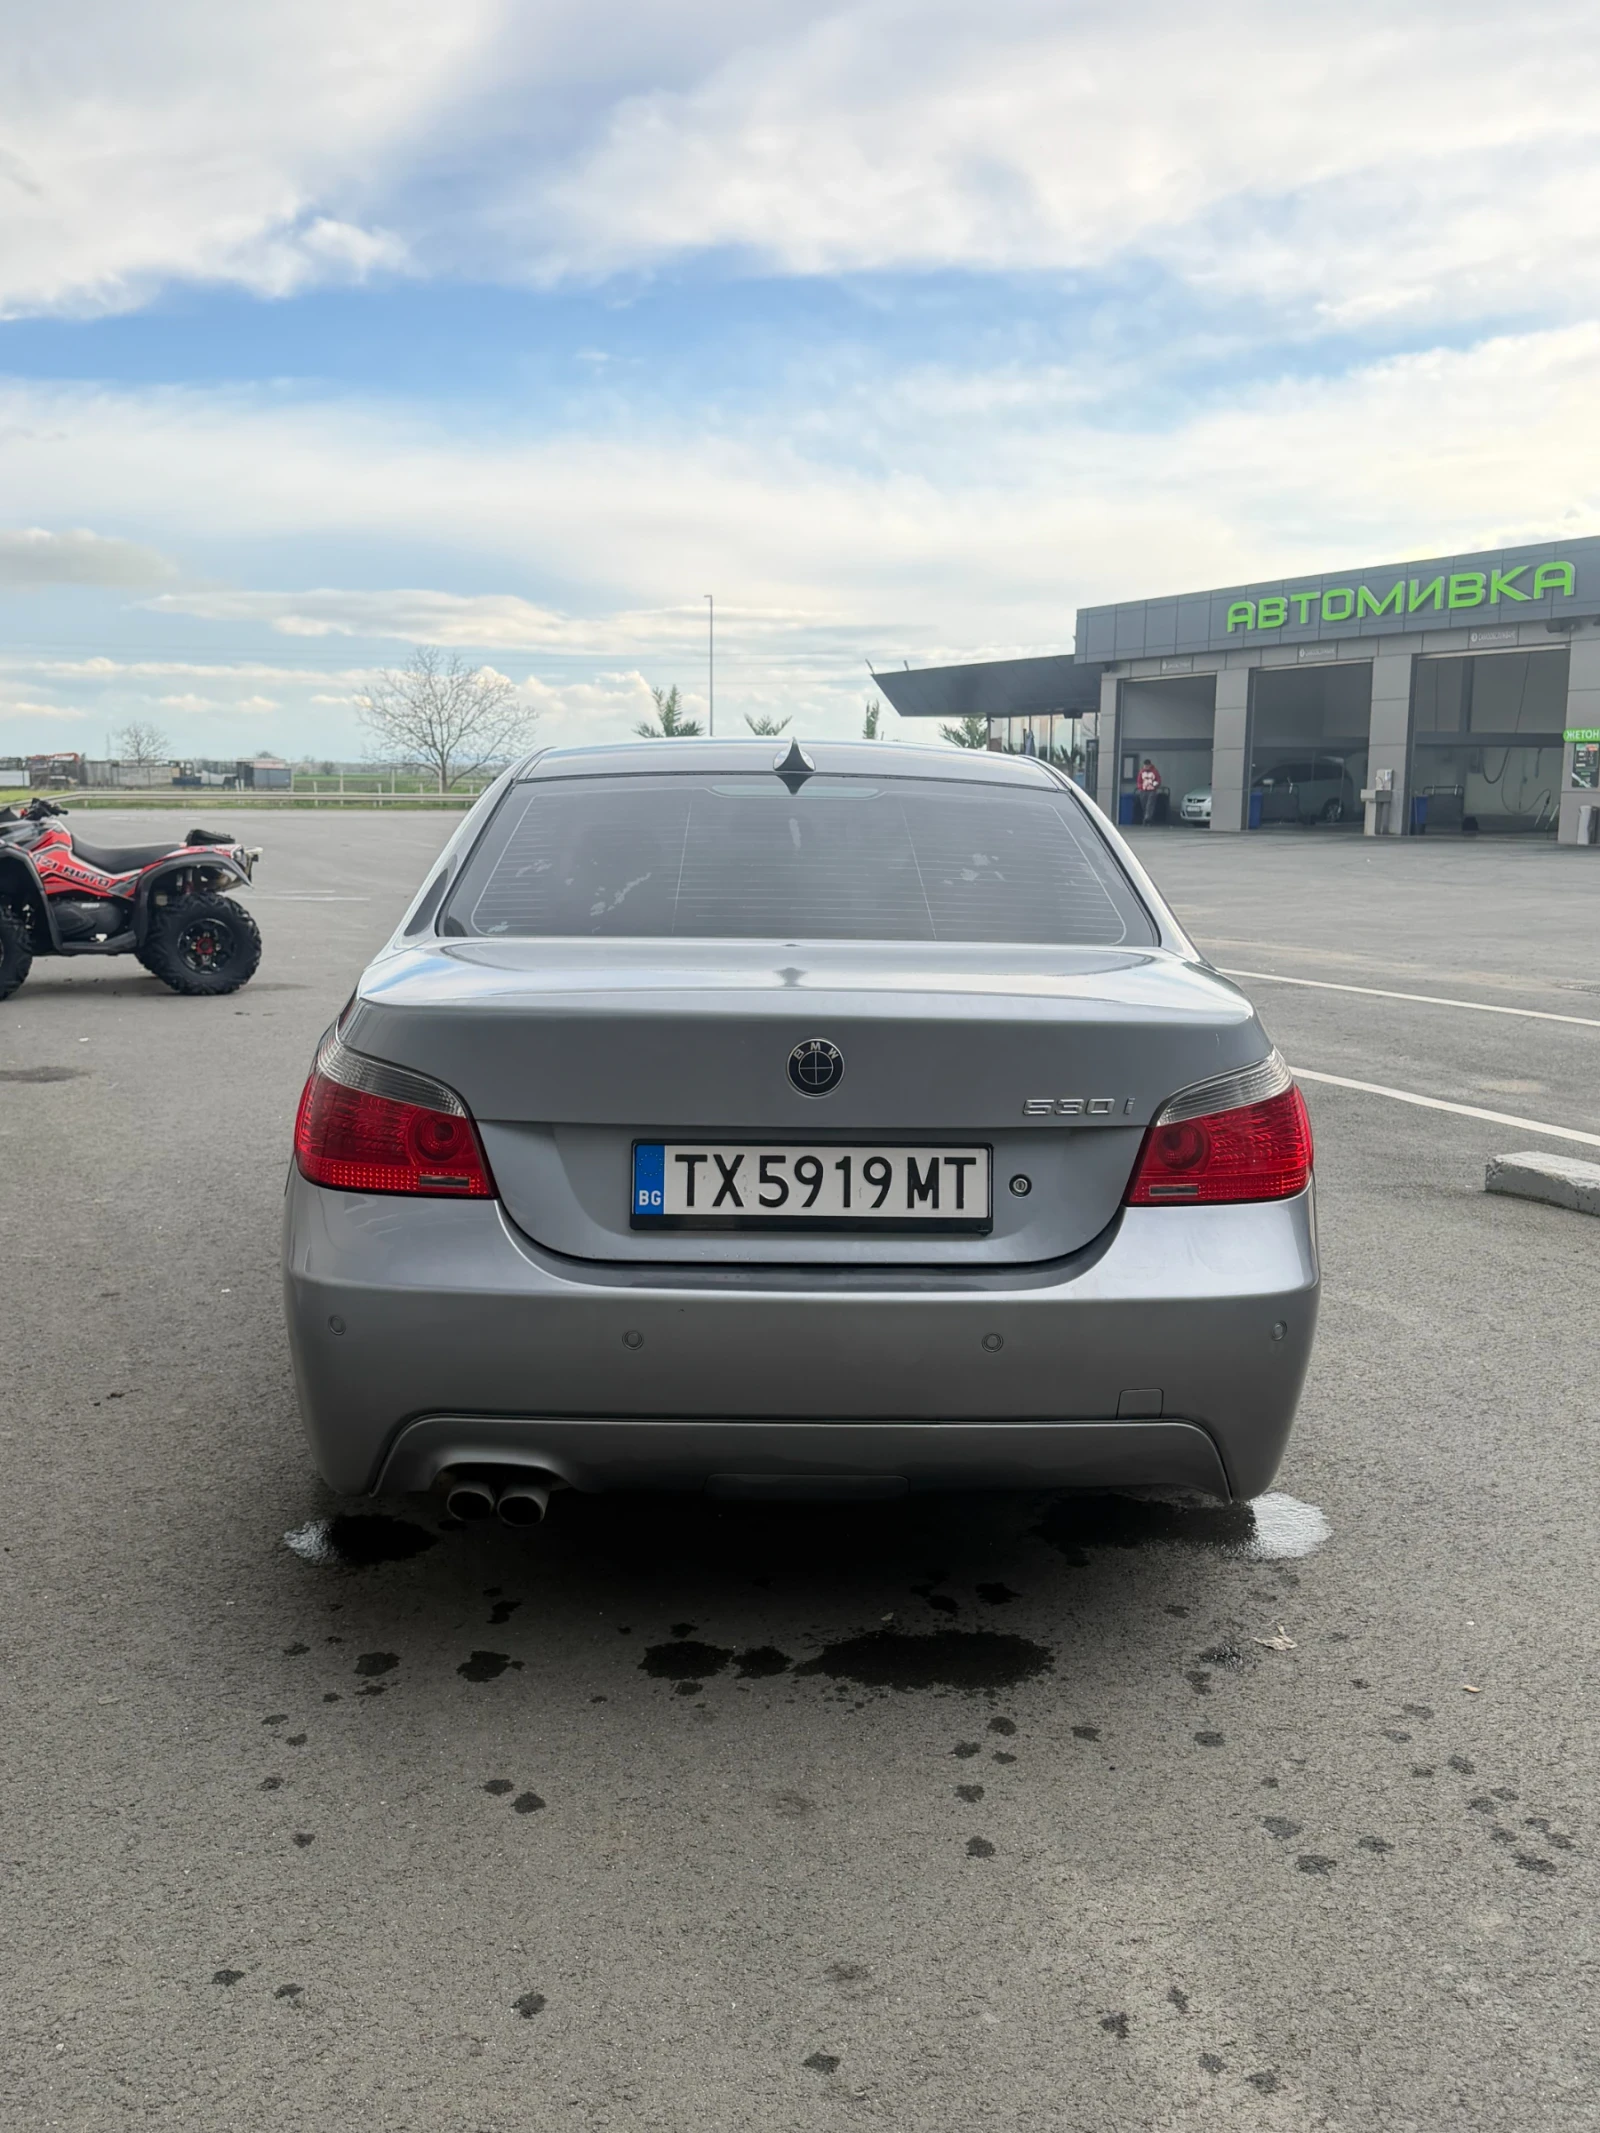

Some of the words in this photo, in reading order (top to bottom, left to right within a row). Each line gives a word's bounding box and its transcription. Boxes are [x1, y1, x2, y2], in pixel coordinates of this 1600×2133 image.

[1227, 561, 1575, 633] АВТОМИВКА
[63, 866, 110, 887] AUTO
[793, 1041, 839, 1060] BMW
[639, 1190, 661, 1206] BG
